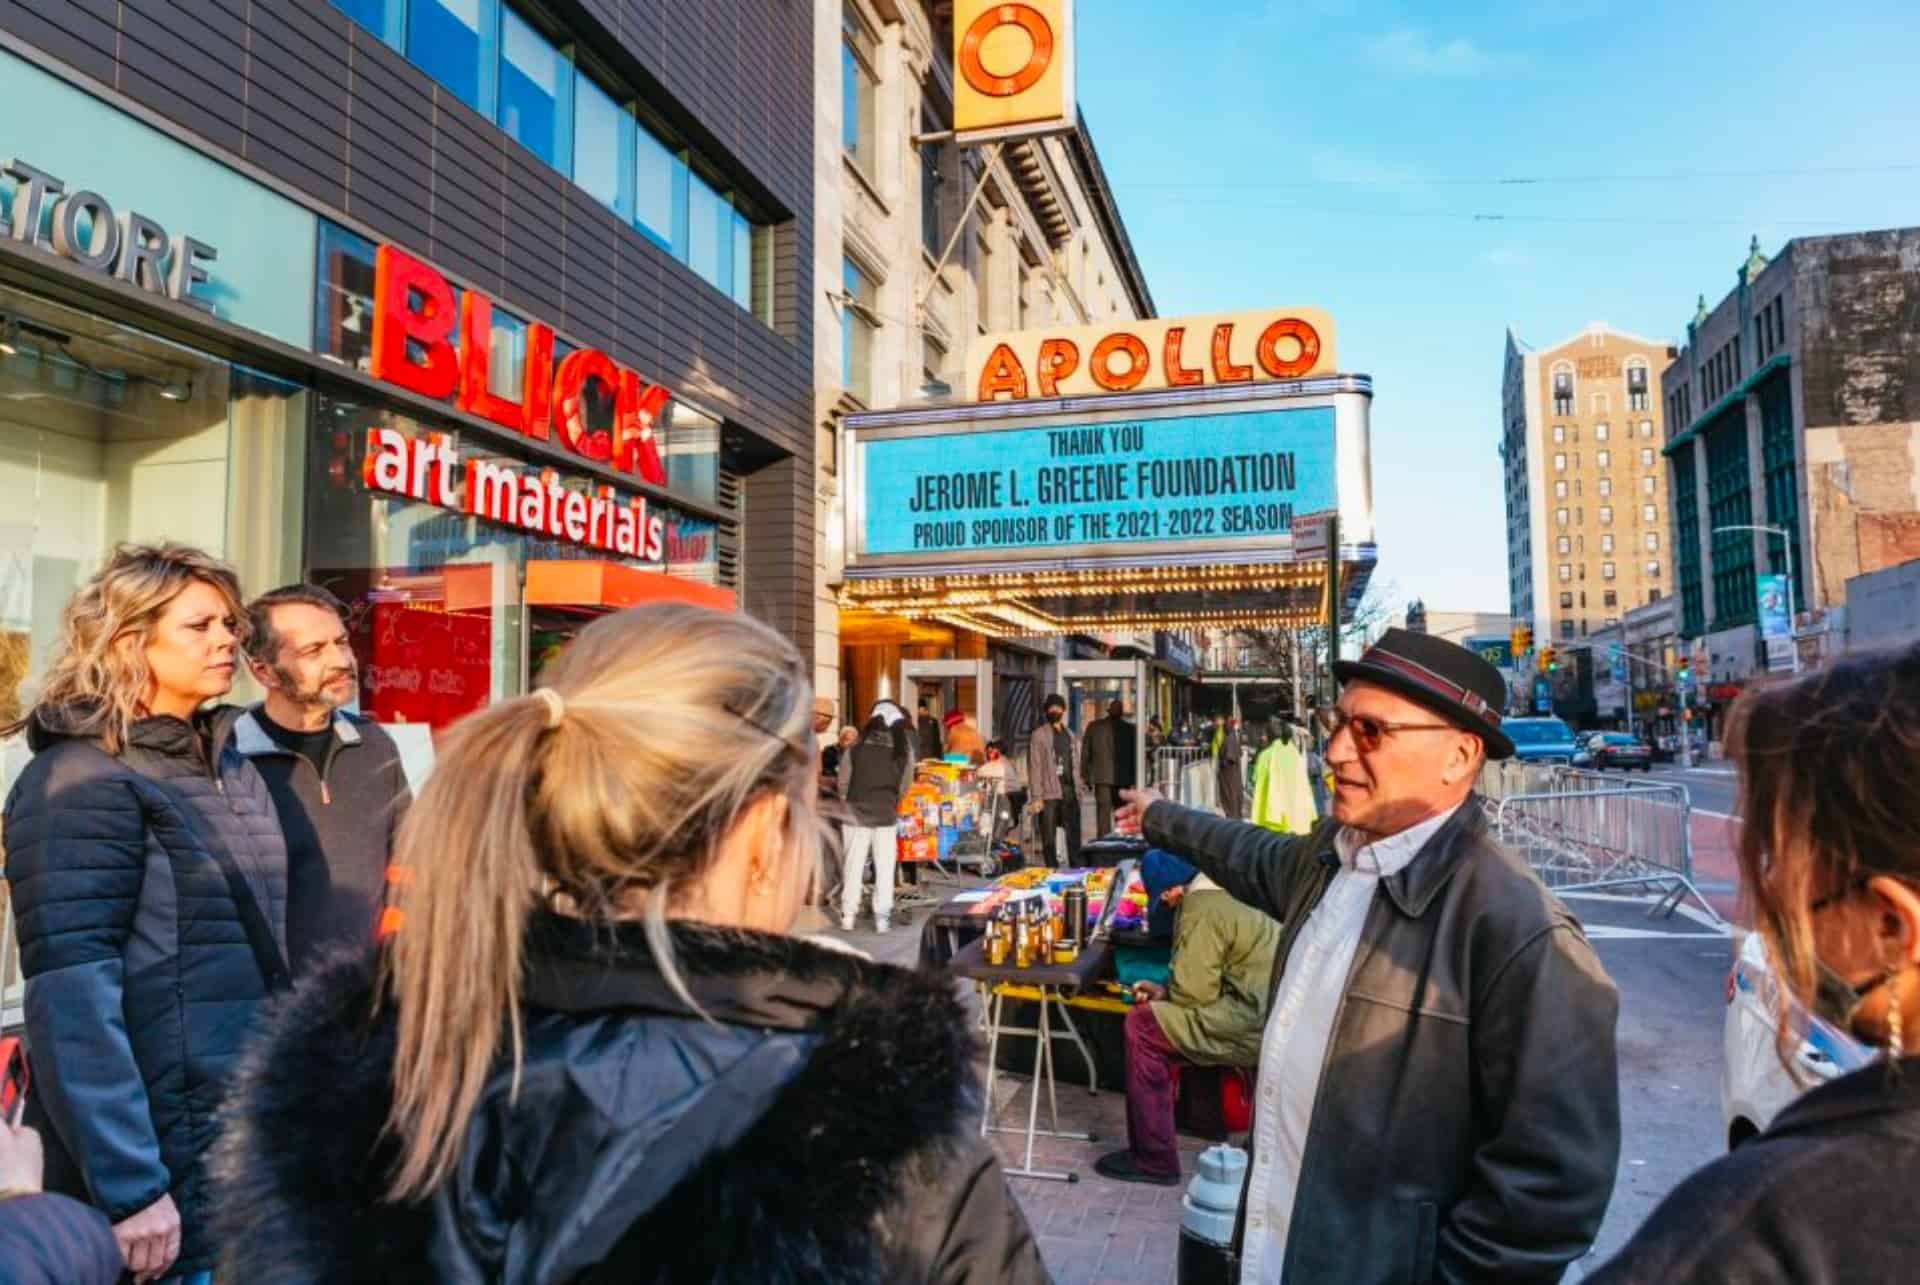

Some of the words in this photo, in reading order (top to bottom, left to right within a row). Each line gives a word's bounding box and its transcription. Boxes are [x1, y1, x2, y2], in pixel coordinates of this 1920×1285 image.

[0, 157, 218, 315] TORE
[371, 244, 671, 487] BLICK
[978, 317, 1321, 401] APOLLO
[909, 472, 1002, 512] JEROME
[1010, 469, 1029, 506] L.
[1038, 463, 1129, 504] GREENE
[1137, 452, 1296, 499] FOUNDATION
[1048, 428, 1105, 457] THANK
[1110, 425, 1144, 453] YOU
[363, 428, 459, 506] art
[466, 462, 664, 562] materials
[914, 520, 965, 548] PROUD
[972, 516, 1048, 544] SPONSOR
[1054, 514, 1075, 540] OF
[1081, 511, 1112, 539] THE
[1117, 507, 1215, 537] 2021-2022
[1221, 502, 1293, 533] SEASON
